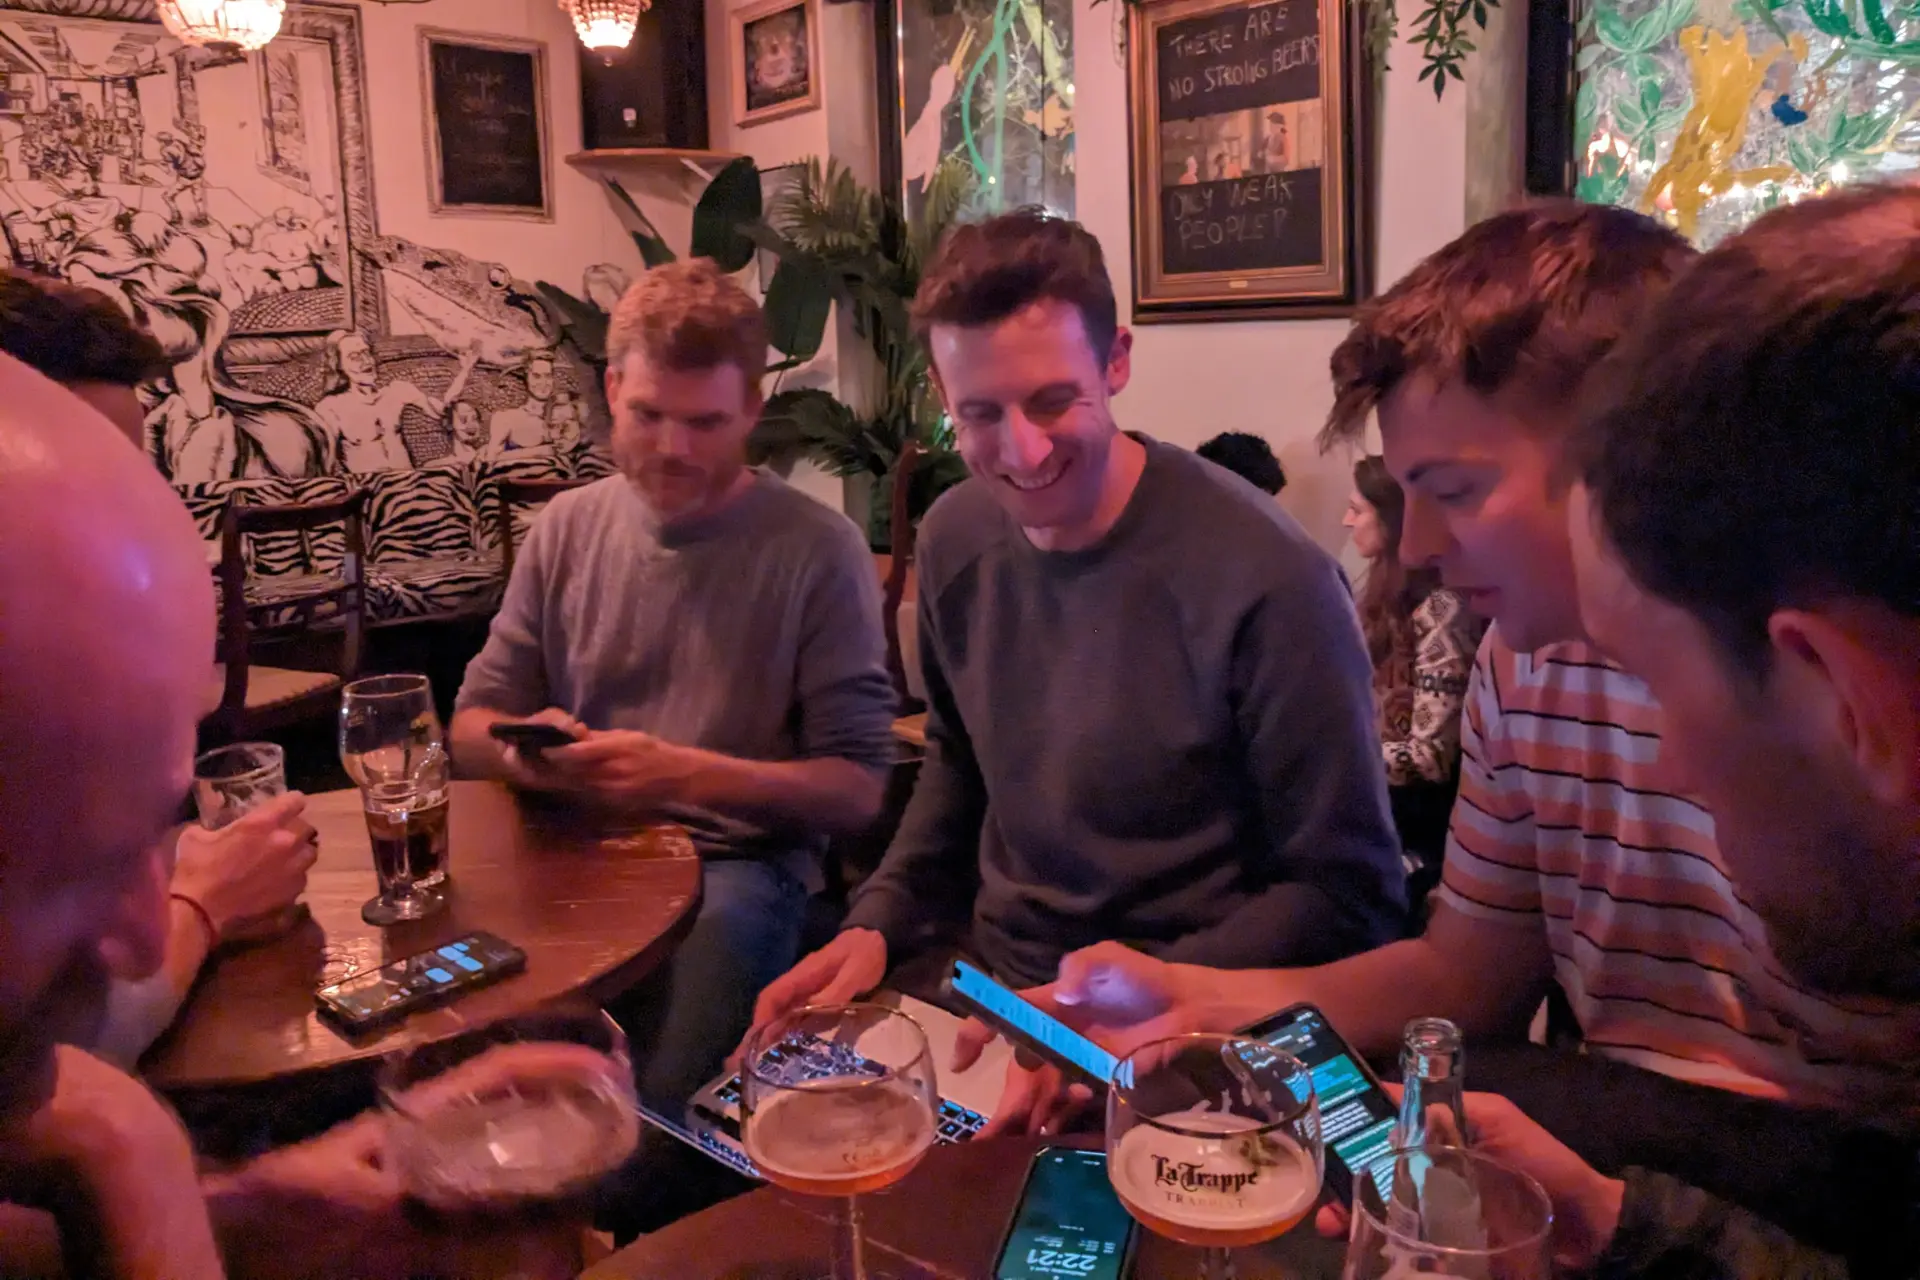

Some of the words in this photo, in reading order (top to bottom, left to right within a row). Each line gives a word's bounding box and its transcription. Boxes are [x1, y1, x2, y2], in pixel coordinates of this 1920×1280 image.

[1169, 26, 1233, 59] THERE
[1244, 7, 1289, 41] ARE
[1169, 76, 1195, 100] NO
[1204, 60, 1268, 93] STRONG
[1273, 35, 1320, 74] BEERS
[1171, 187, 1214, 221] OLY
[1226, 174, 1296, 206] WEAK
[1151, 1154, 1178, 1187] La
[1178, 1162, 1258, 1193] Trappe
[1026, 1249, 1098, 1271] 22:21
